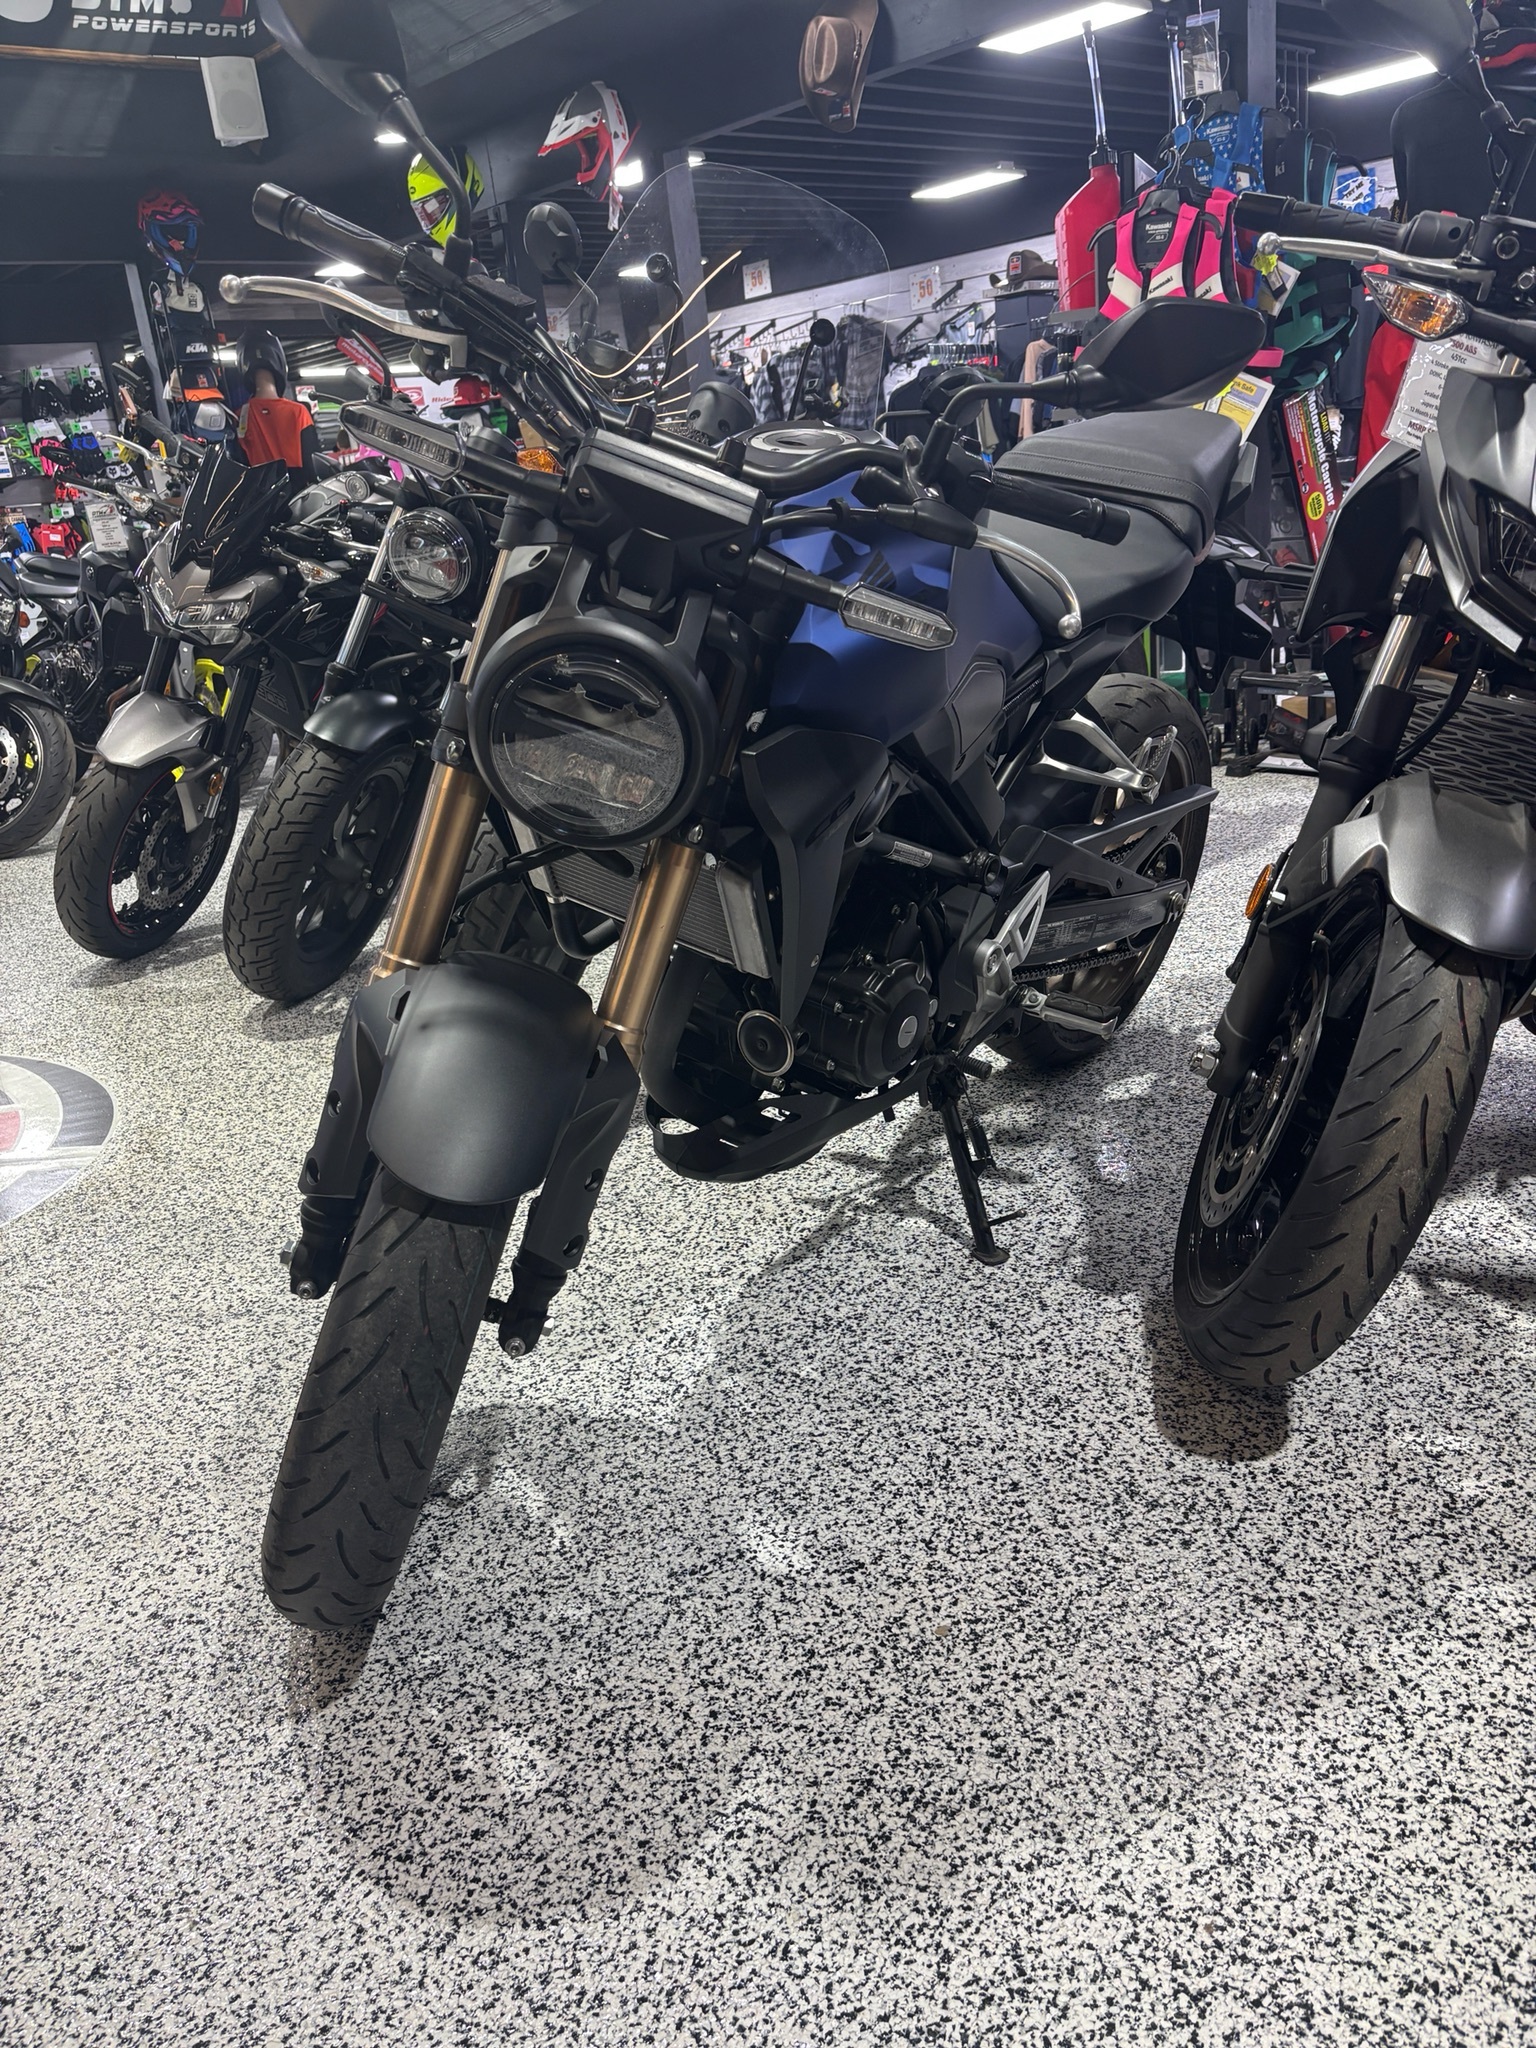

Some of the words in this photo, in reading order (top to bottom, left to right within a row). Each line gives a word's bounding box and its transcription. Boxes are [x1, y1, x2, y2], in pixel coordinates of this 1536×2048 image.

[72, 14, 256, 38] POWERSPORTS
[1206, 123, 1233, 134] Kawasaki
[1145, 221, 1172, 230] Kawasaki
[1149, 275, 1174, 294] Kawasaki
[186, 342, 208, 353] KTM
[1320, 411, 1329, 432] LOAD
[1408, 420, 1426, 433] MSRP
[1307, 389, 1326, 462] Motorcycle
[1321, 461, 1335, 506] Carrier
